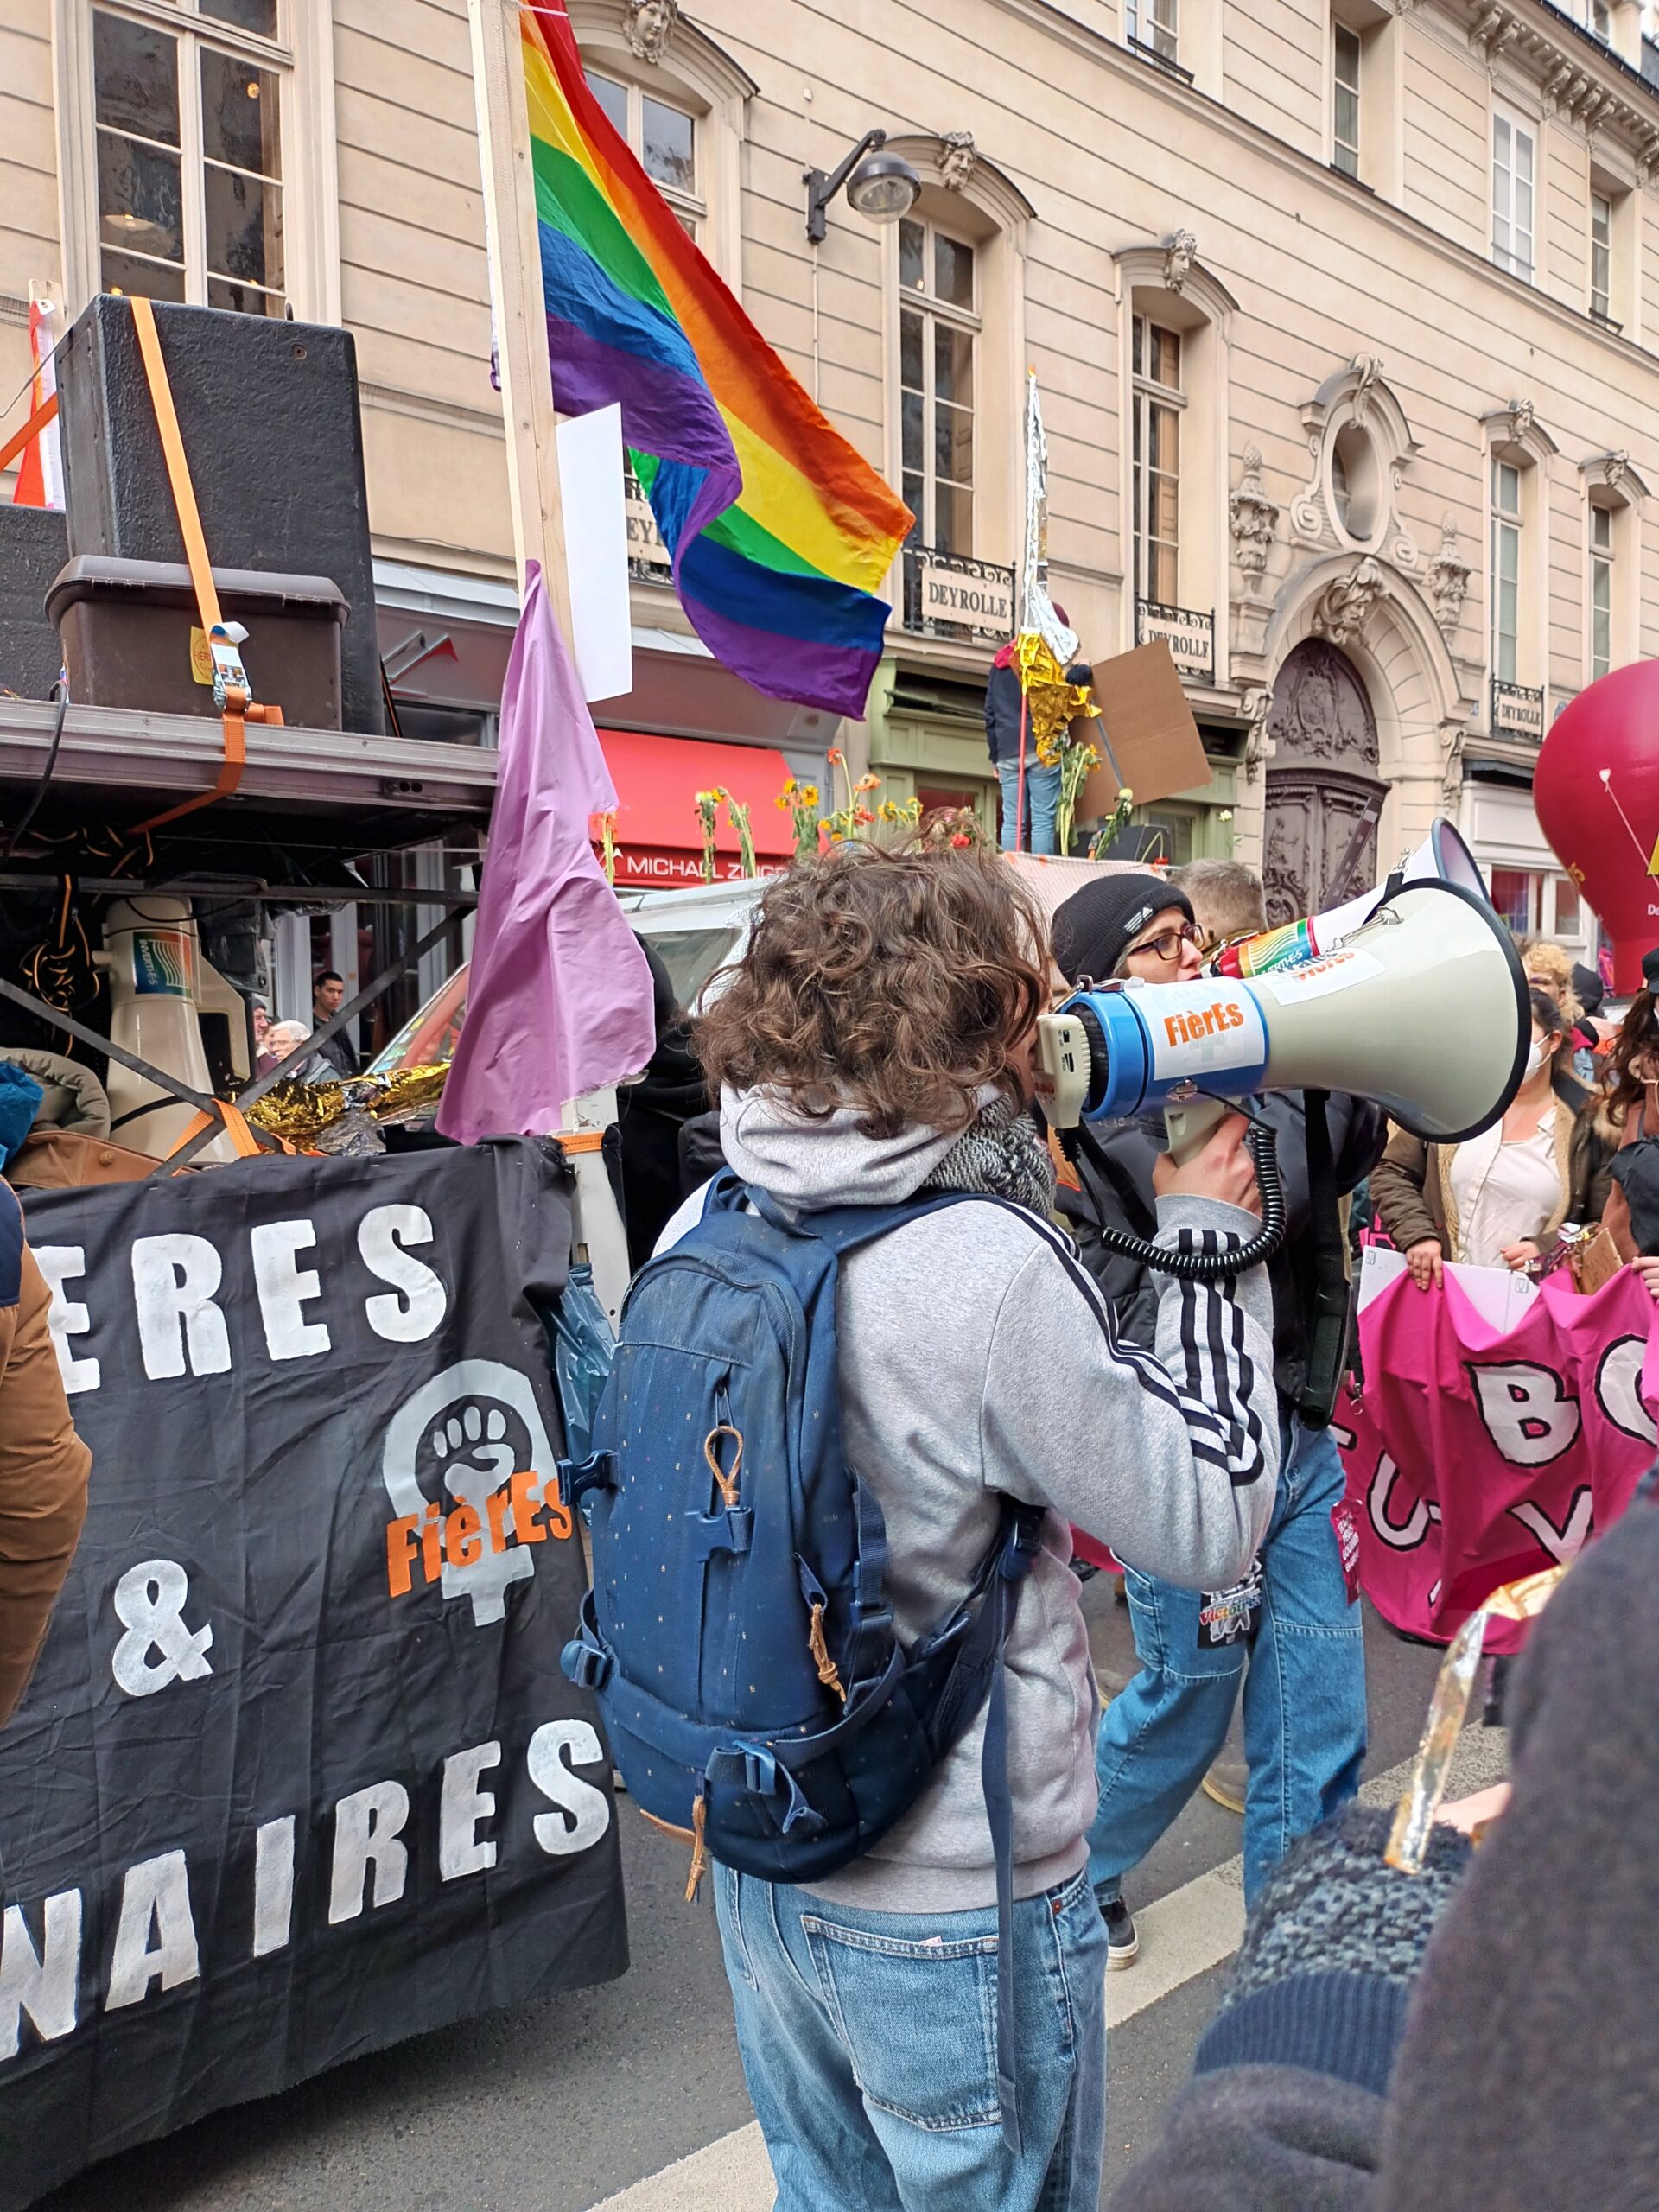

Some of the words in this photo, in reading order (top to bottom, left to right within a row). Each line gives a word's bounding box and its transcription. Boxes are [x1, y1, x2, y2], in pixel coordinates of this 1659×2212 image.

[928, 582, 1008, 619] DEYROLLE
[1163, 1002, 1244, 1047] FièrEs
[386, 1471, 573, 1598] FièrEs
[112, 1559, 214, 1697] &
[0, 1719, 610, 2063] NAIRES
